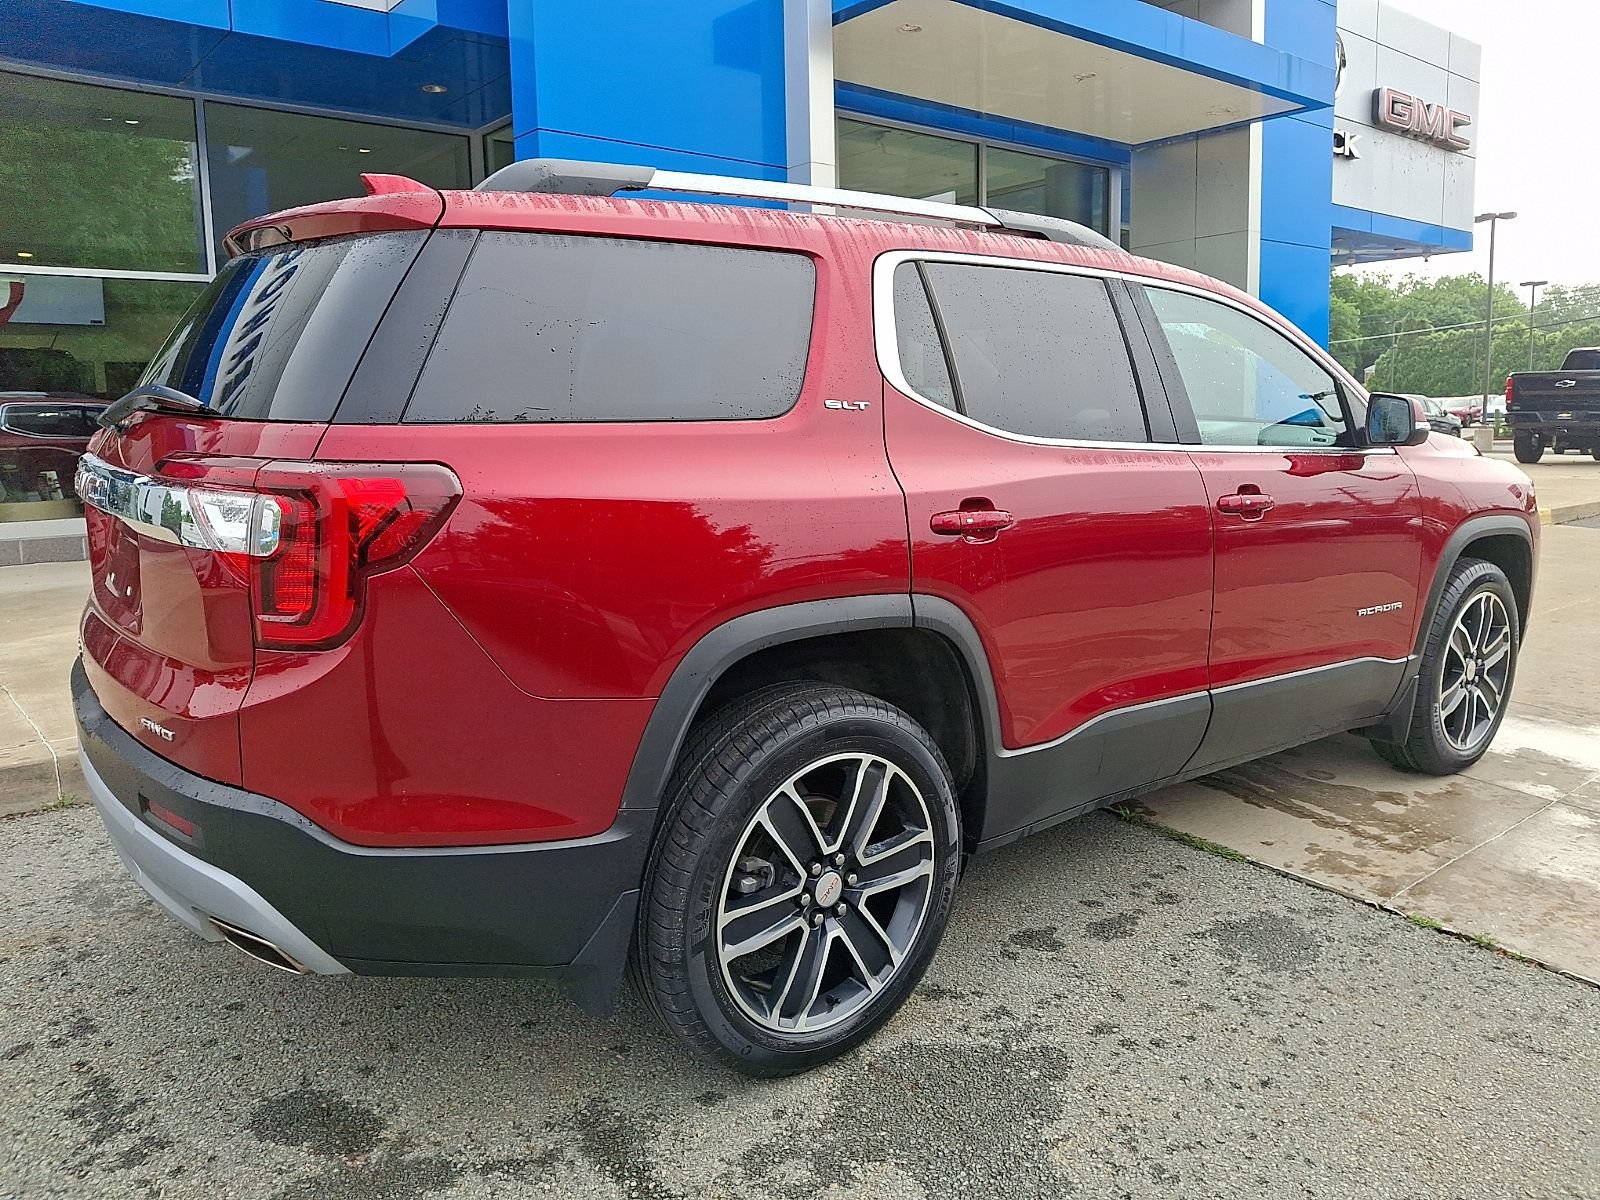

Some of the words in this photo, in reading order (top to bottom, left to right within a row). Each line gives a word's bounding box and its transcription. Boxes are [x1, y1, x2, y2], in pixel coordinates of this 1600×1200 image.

[1384, 86, 1472, 150] GMC
[824, 399, 871, 411] SLT
[1357, 601, 1403, 616] ACADIA
[140, 717, 176, 742] AWD
